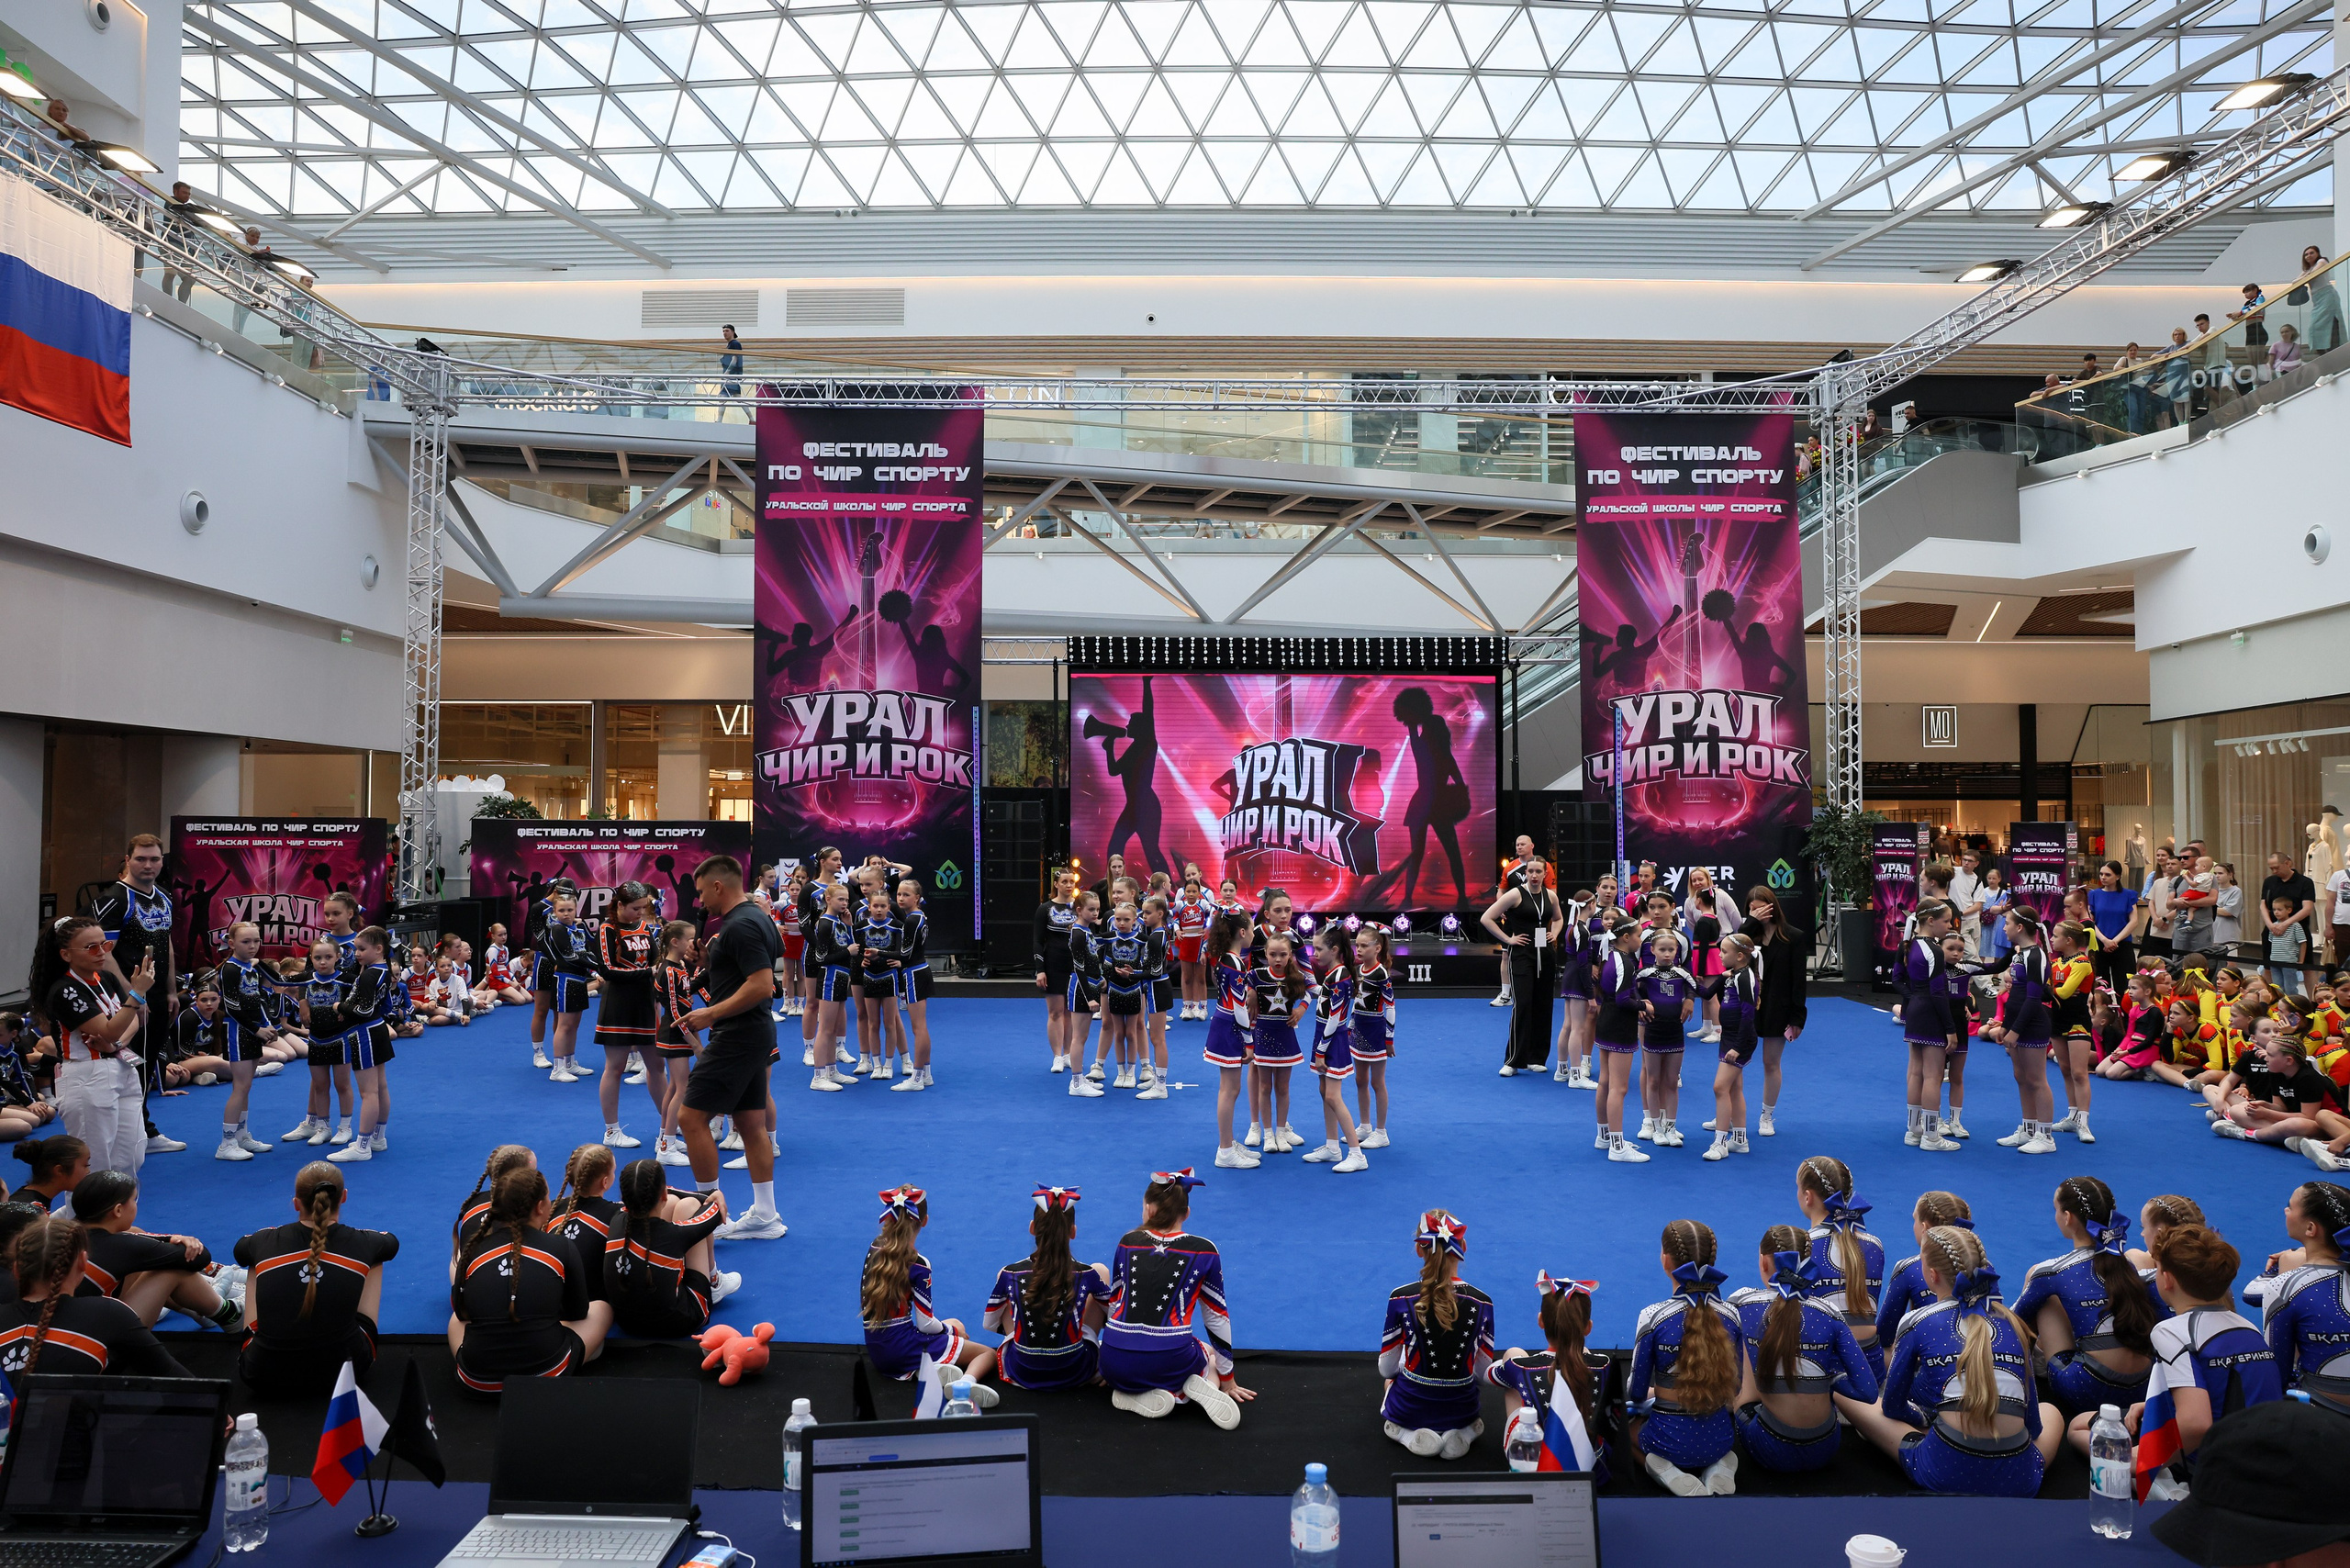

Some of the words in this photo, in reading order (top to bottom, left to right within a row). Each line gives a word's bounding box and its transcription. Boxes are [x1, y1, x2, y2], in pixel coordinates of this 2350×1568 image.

[802, 442, 948, 459] ФЕСТИВАЛЬ
[1620, 446, 1762, 463] ФЕСТИВАЛЬ
[767, 465, 802, 481] ПО
[813, 465, 862, 481] ЧИР
[873, 466, 971, 482] СПОРТУ
[1587, 469, 1620, 485] ПО
[1631, 469, 1680, 484] ЧИР
[1691, 469, 1784, 485] СПОРТУ
[765, 499, 828, 511] УРАЛЬСКОЙ
[833, 502, 877, 511] ШКОЛЫ
[881, 502, 907, 512] ЧИР
[912, 502, 967, 512] СПОРТА
[1585, 502, 1648, 513] УРАЛЬСКОЙ
[1652, 504, 1695, 512] ШКОЛЫ
[1700, 503, 1725, 512] ЧИР
[1730, 503, 1783, 513] СПОРТА
[786, 691, 948, 747] УРАЛ
[1614, 691, 1776, 745] УРАЛ
[1930, 711, 1950, 739] MO
[764, 744, 847, 786] ЧИР
[856, 743, 882, 775] И
[890, 744, 973, 788] РОК
[1592, 744, 1674, 788] ЧИР
[1683, 742, 1709, 775] И
[1718, 742, 1803, 785] РОК
[1233, 743, 1327, 809] УРАЛ
[185, 823, 257, 834] ФЕСТИВАЛЬ
[262, 823, 279, 832] ПО
[283, 823, 308, 833] ЧИР
[312, 823, 360, 833] СПОРТУ
[517, 827, 594, 838] ФЕСТИВАЛЬ
[599, 828, 618, 837] ПО
[623, 828, 649, 837] ЧИР
[655, 828, 706, 838] СПОРТУ
[1219, 807, 1259, 851] ЧИР
[1262, 805, 1280, 845] И
[1283, 805, 1346, 867] РОК
[196, 838, 250, 847] УРАЛЬСКАЯ
[308, 839, 344, 847] СПОРТА
[536, 843, 588, 851] УРАЛЬСКАЯ
[590, 843, 621, 851] ШКОЛА
[623, 843, 642, 851] ЧИР
[1875, 873, 1892, 881] ЧИР
[1893, 872, 1897, 880] И
[1898, 873, 1916, 882] РОК
[1880, 863, 1911, 875] УРАЛ
[2020, 872, 2059, 886] УРАЛ
[2014, 884, 2032, 895] ЧИР
[2035, 884, 2042, 892] И
[2044, 885, 2065, 896] РОК
[227, 894, 318, 926] УРАЛ
[263, 924, 279, 944] И
